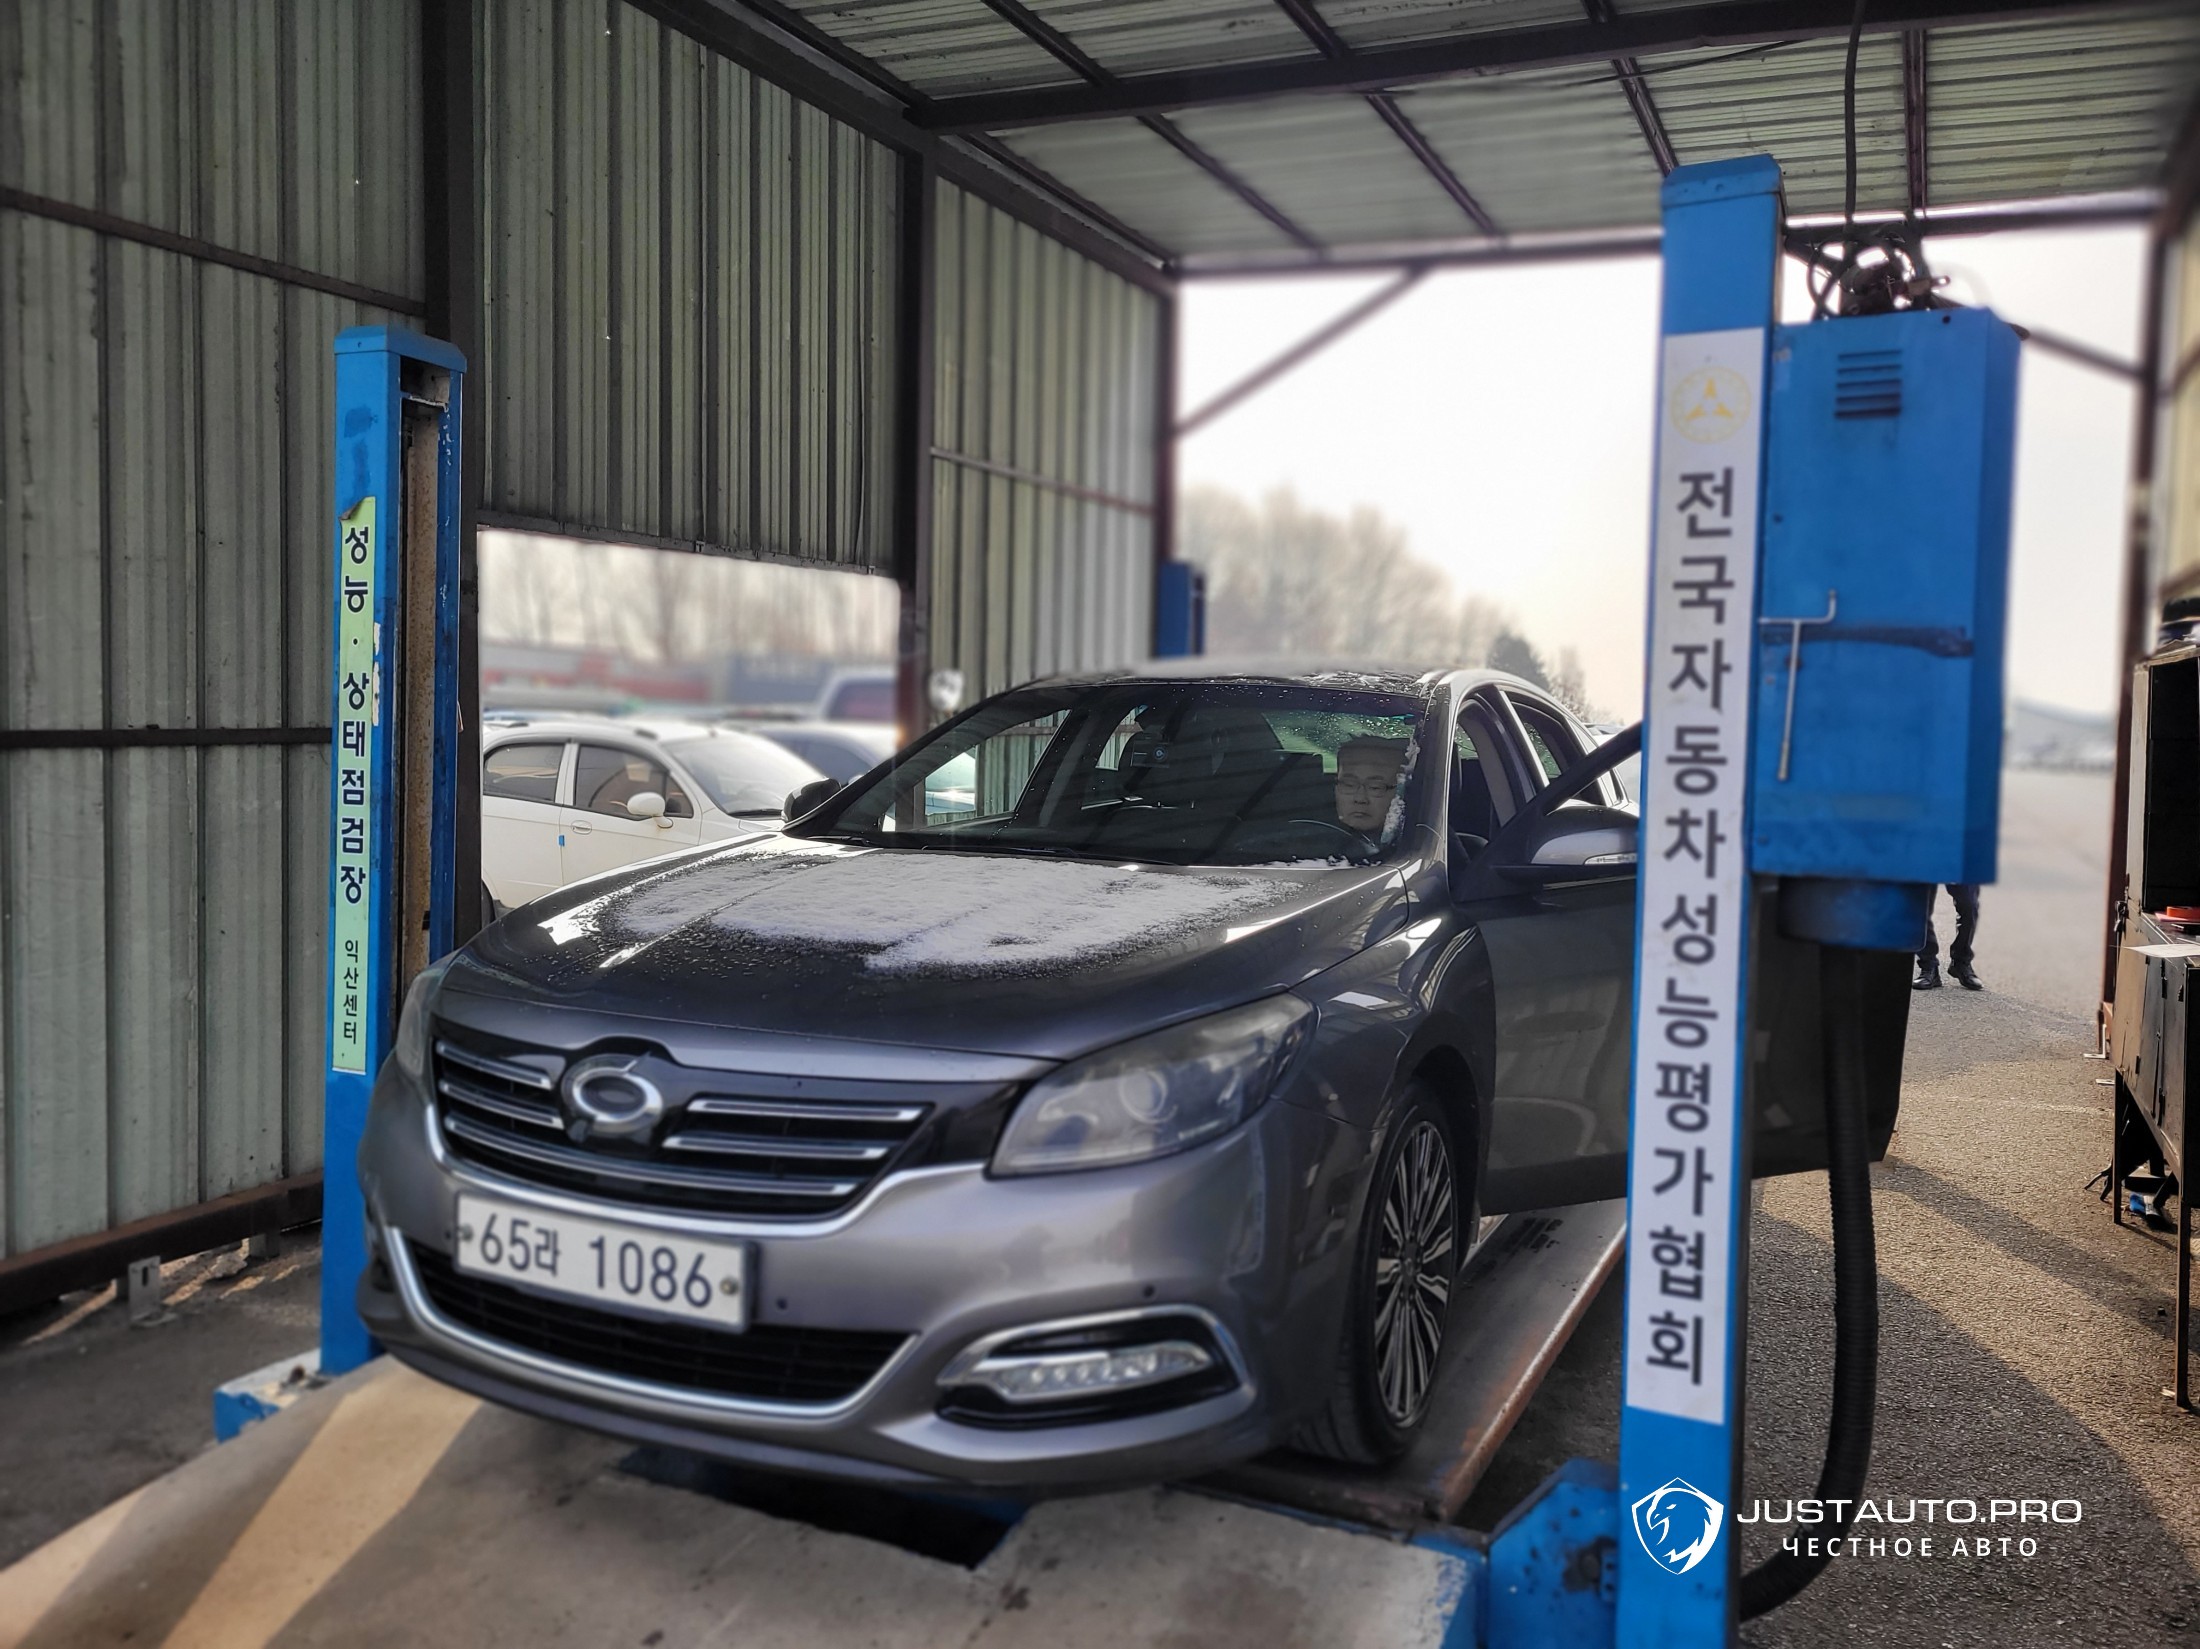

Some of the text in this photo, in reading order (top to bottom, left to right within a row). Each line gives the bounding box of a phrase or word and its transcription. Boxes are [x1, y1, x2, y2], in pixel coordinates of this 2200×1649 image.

[1646, 466, 1735, 1386] 전국자동차성능평가협회
[342, 939, 360, 1045] 익산센터
[479, 1212, 713, 1309] 65라 1086
